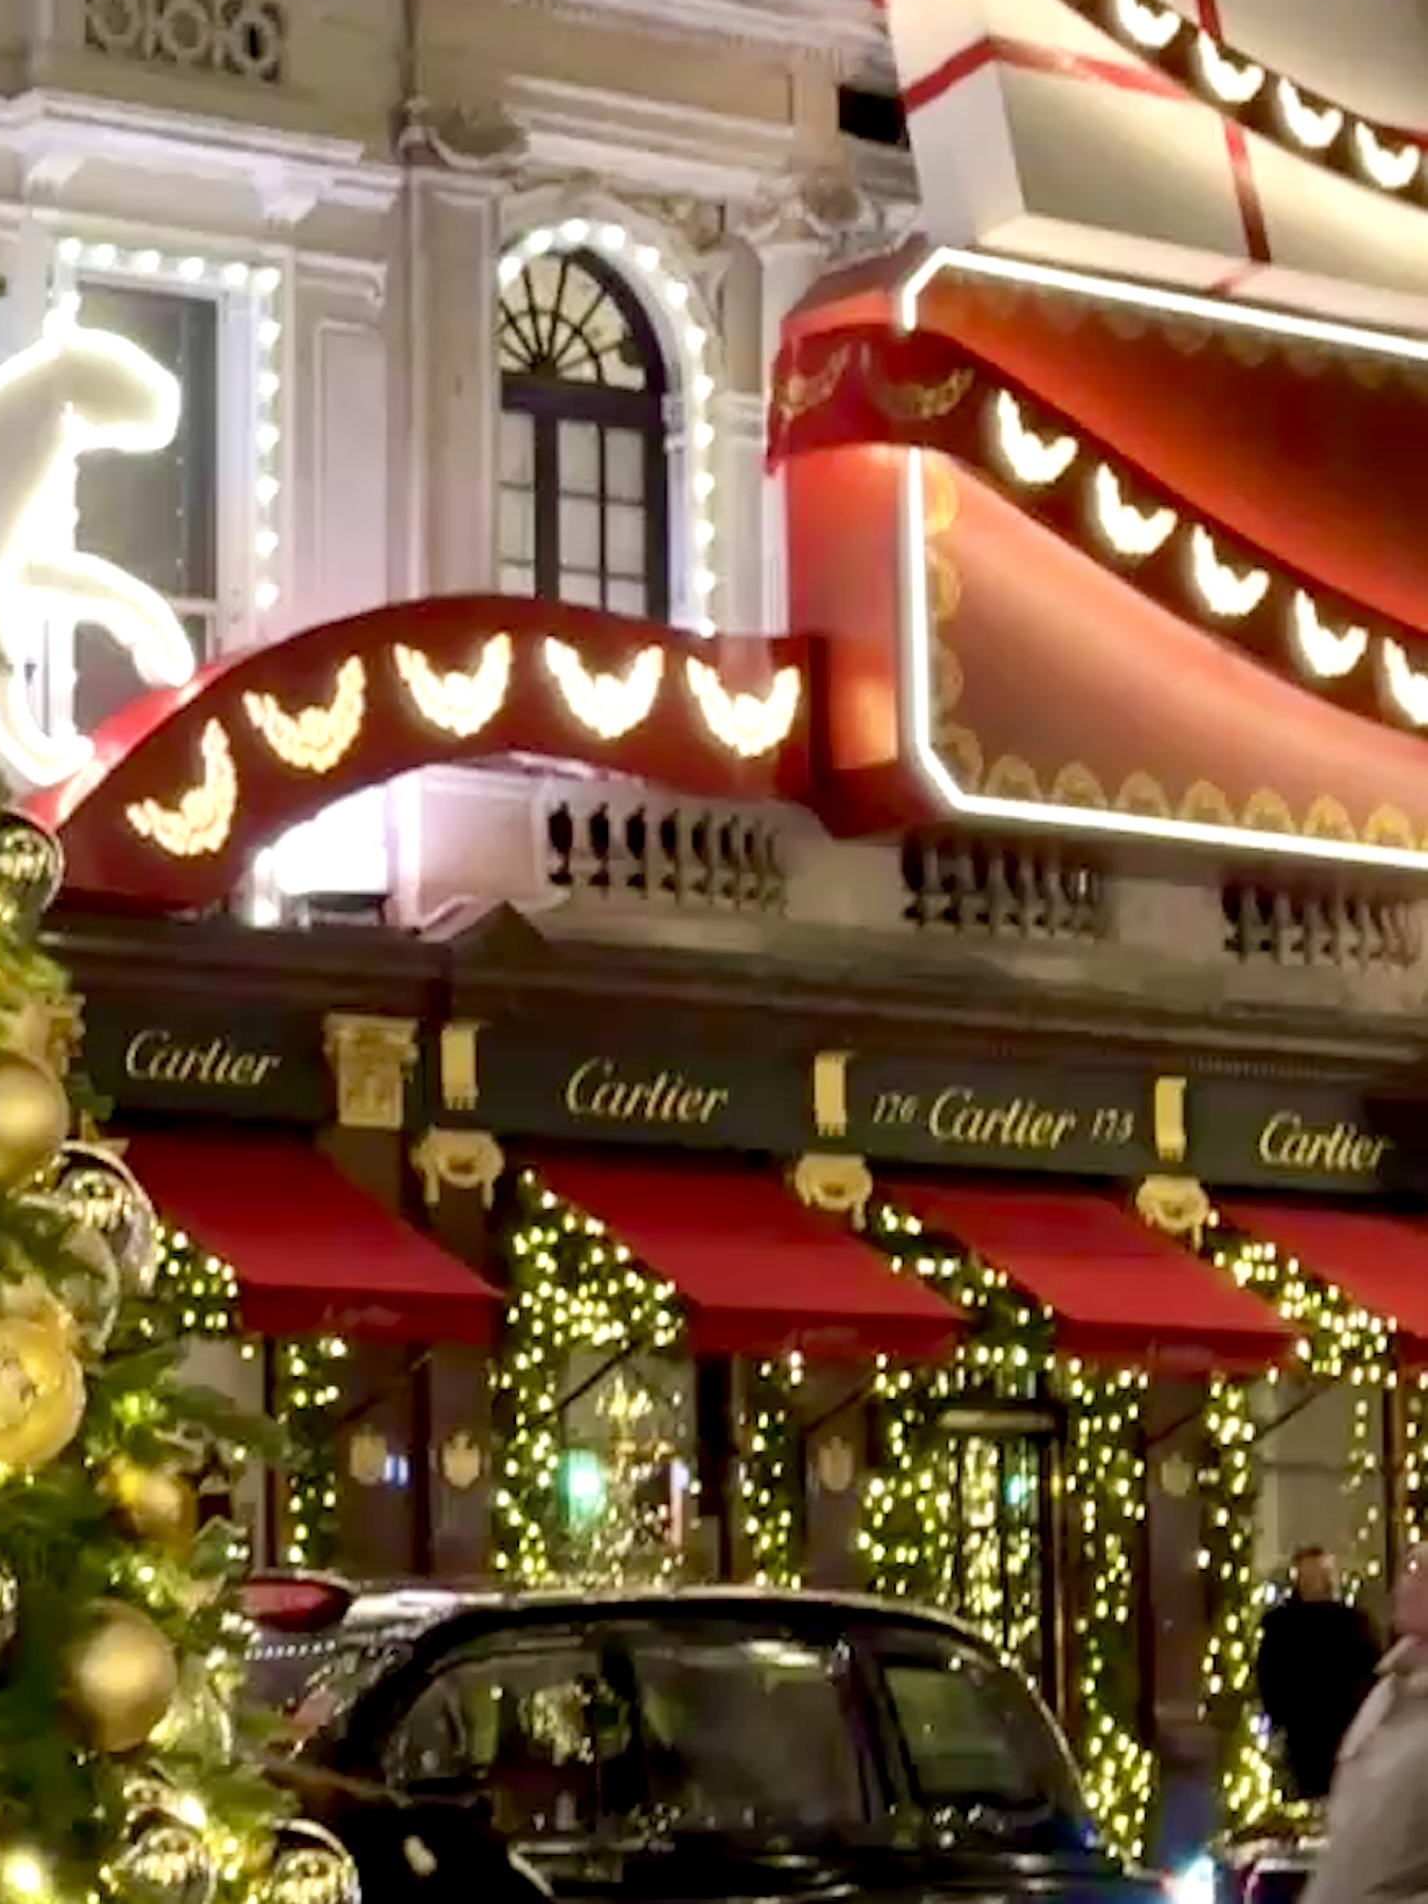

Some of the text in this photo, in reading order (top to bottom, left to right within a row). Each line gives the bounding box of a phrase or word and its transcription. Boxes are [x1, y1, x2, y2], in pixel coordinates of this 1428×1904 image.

[125, 1029, 282, 1087] Cartier
[565, 1056, 730, 1124] Cartier
[928, 1086, 1077, 1149] Cartier
[1257, 1110, 1392, 1172] Cartier
